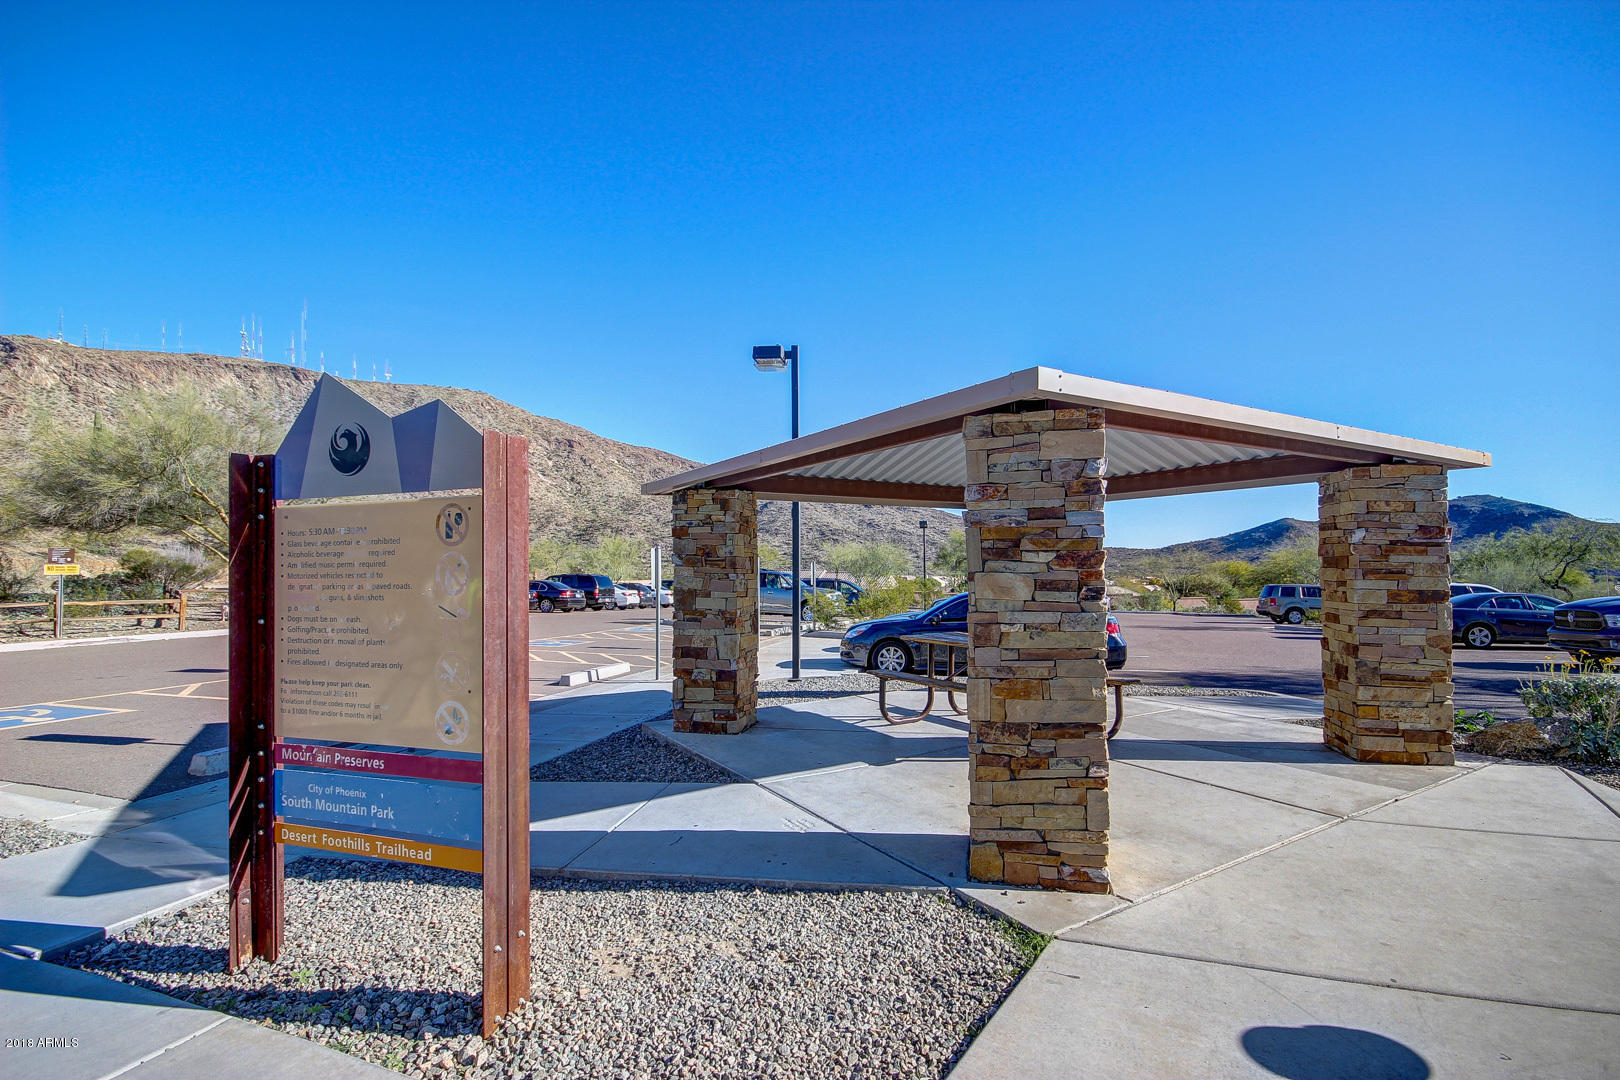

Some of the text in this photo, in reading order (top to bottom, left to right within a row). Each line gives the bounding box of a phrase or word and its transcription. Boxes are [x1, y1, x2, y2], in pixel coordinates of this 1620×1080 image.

[323, 527, 335, 536] AM
[287, 540, 302, 548] Glass
[304, 539, 331, 550] beveage
[287, 549, 314, 558] Alcoholic
[316, 549, 344, 560] beverage
[368, 547, 396, 559] reqired
[287, 560, 317, 569] Amlified
[337, 559, 359, 571] permi
[287, 570, 383, 580] Motorized vehicles resrictd to
[322, 581, 346, 593] parking
[348, 582, 364, 590] aras
[354, 594, 384, 603] slinshots
[287, 615, 302, 625] Dogs
[304, 615, 319, 623] must
[320, 615, 328, 623] be
[343, 616, 361, 624] eash
[287, 638, 322, 646] Destruction
[303, 659, 327, 667] allowed
[336, 660, 370, 671] designated
[372, 662, 389, 670] areas
[299, 679, 311, 688] help
[312, 680, 326, 689] keep
[345, 702, 356, 711] may
[334, 752, 385, 770] Preserves
[308, 783, 367, 799] City of Phoenix
[281, 794, 395, 820] South Mountain Park
[281, 828, 433, 862] Desert Foothills Trailhead
